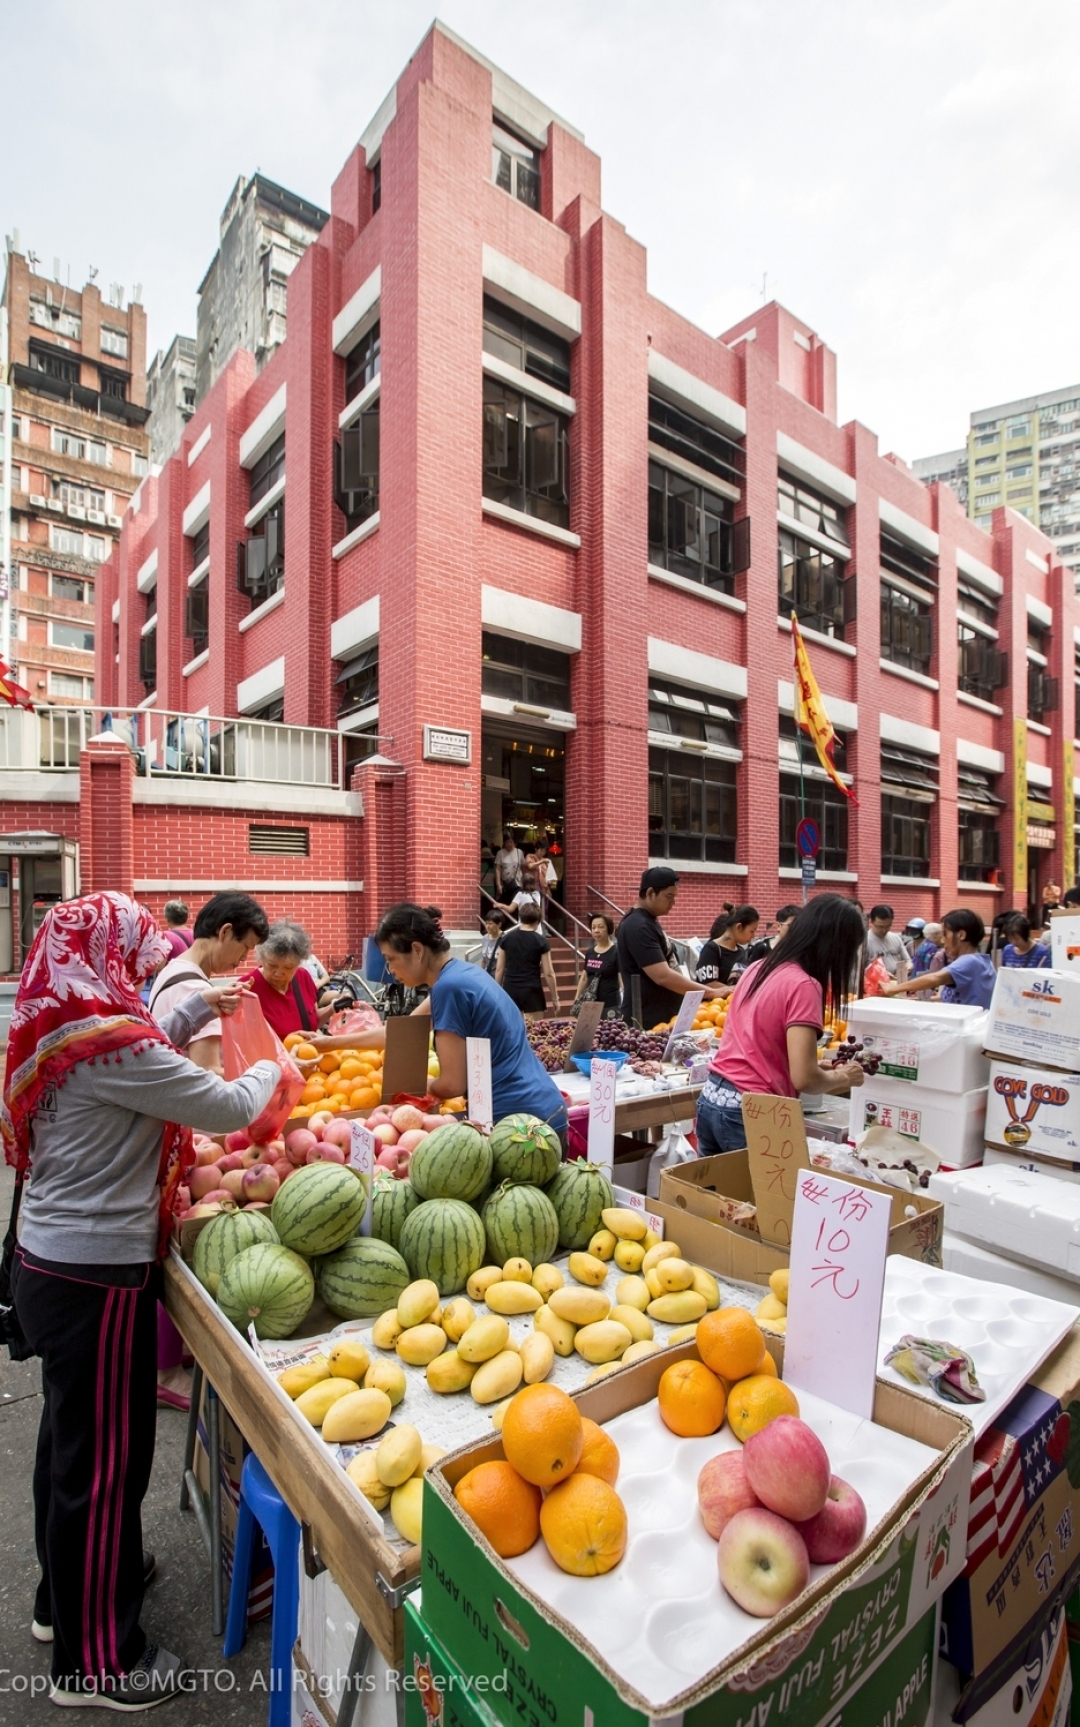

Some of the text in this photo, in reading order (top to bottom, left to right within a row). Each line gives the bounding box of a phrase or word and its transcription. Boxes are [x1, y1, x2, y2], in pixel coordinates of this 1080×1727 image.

[1032, 980, 1055, 995] sk
[594, 1081, 613, 1101] 30
[994, 1076, 1070, 1107] COVE GOLD
[593, 1103, 612, 1124] 元
[901, 1121, 918, 1134] 46
[353, 1146, 369, 1169] 26
[759, 1134, 794, 1159] 20
[815, 1217, 851, 1253] 10
[810, 1258, 860, 1300] 元
[427, 1549, 557, 1723] CRYSTAL FUJI APPLE
[779, 1567, 901, 1713] CRYSTAL FUJI
[830, 1604, 900, 1701] ZEZE
[894, 1653, 928, 1727] APPLE
